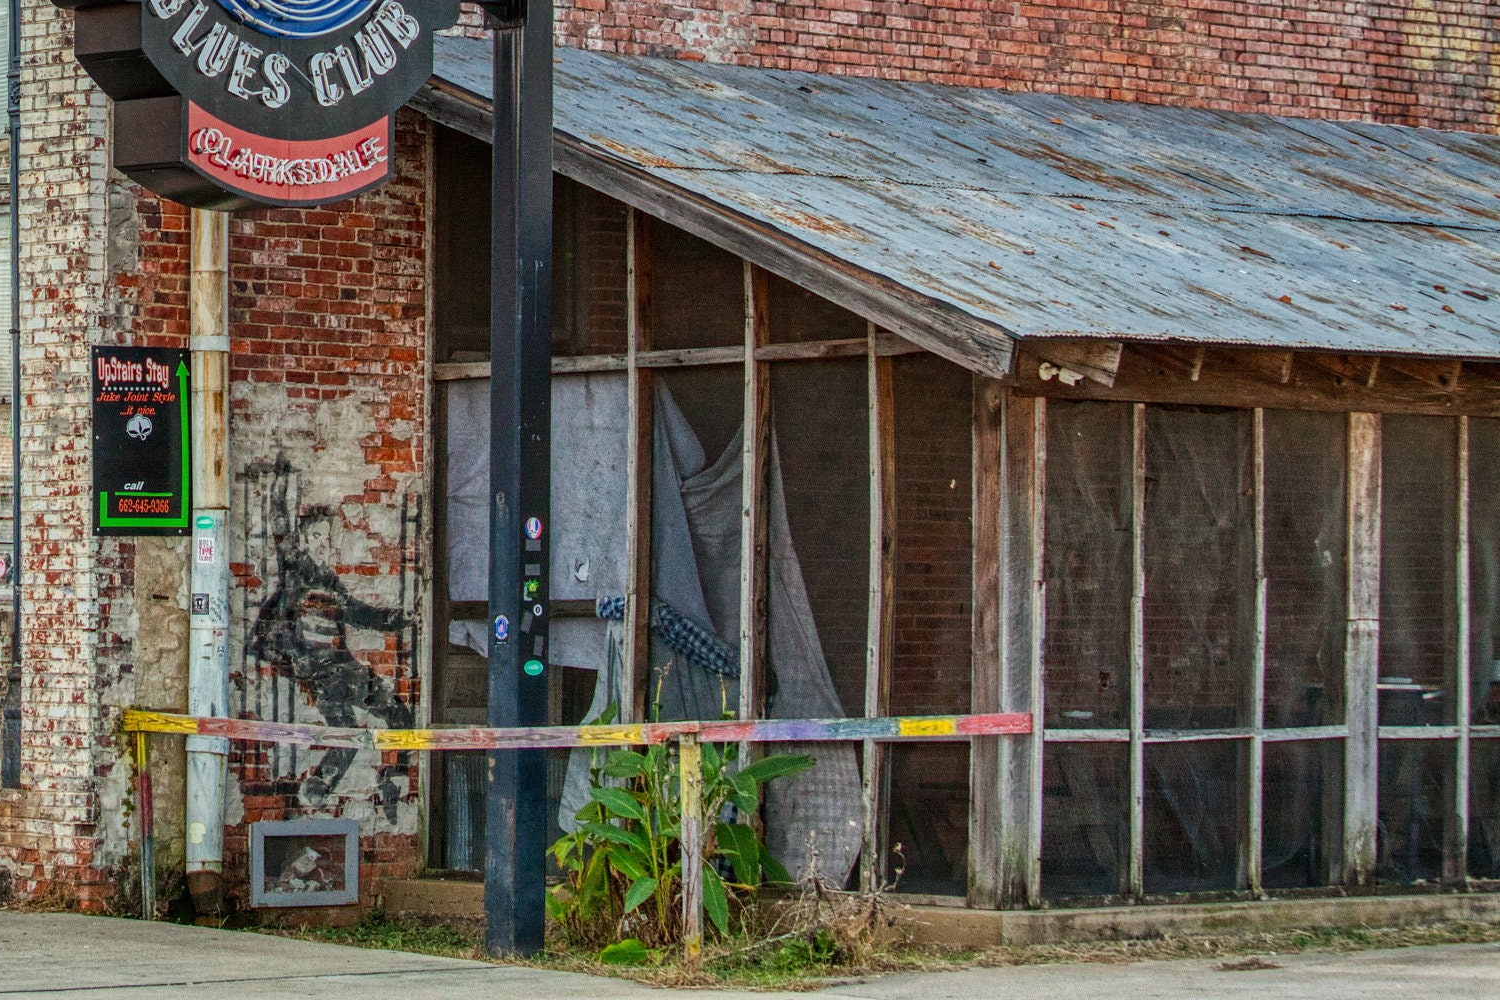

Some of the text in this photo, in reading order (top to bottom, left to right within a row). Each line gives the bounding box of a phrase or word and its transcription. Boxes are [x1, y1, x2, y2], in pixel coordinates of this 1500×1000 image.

[310, 0, 420, 107] CLUB
[190, 127, 388, 186] CLARKSDALE
[98, 356, 170, 389] UpStairs Stay
[97, 391, 176, 404] Juke Joint Style
[136, 408, 156, 416] nice.
[124, 481, 144, 491] call
[118, 499, 169, 513] 662-645-9366
